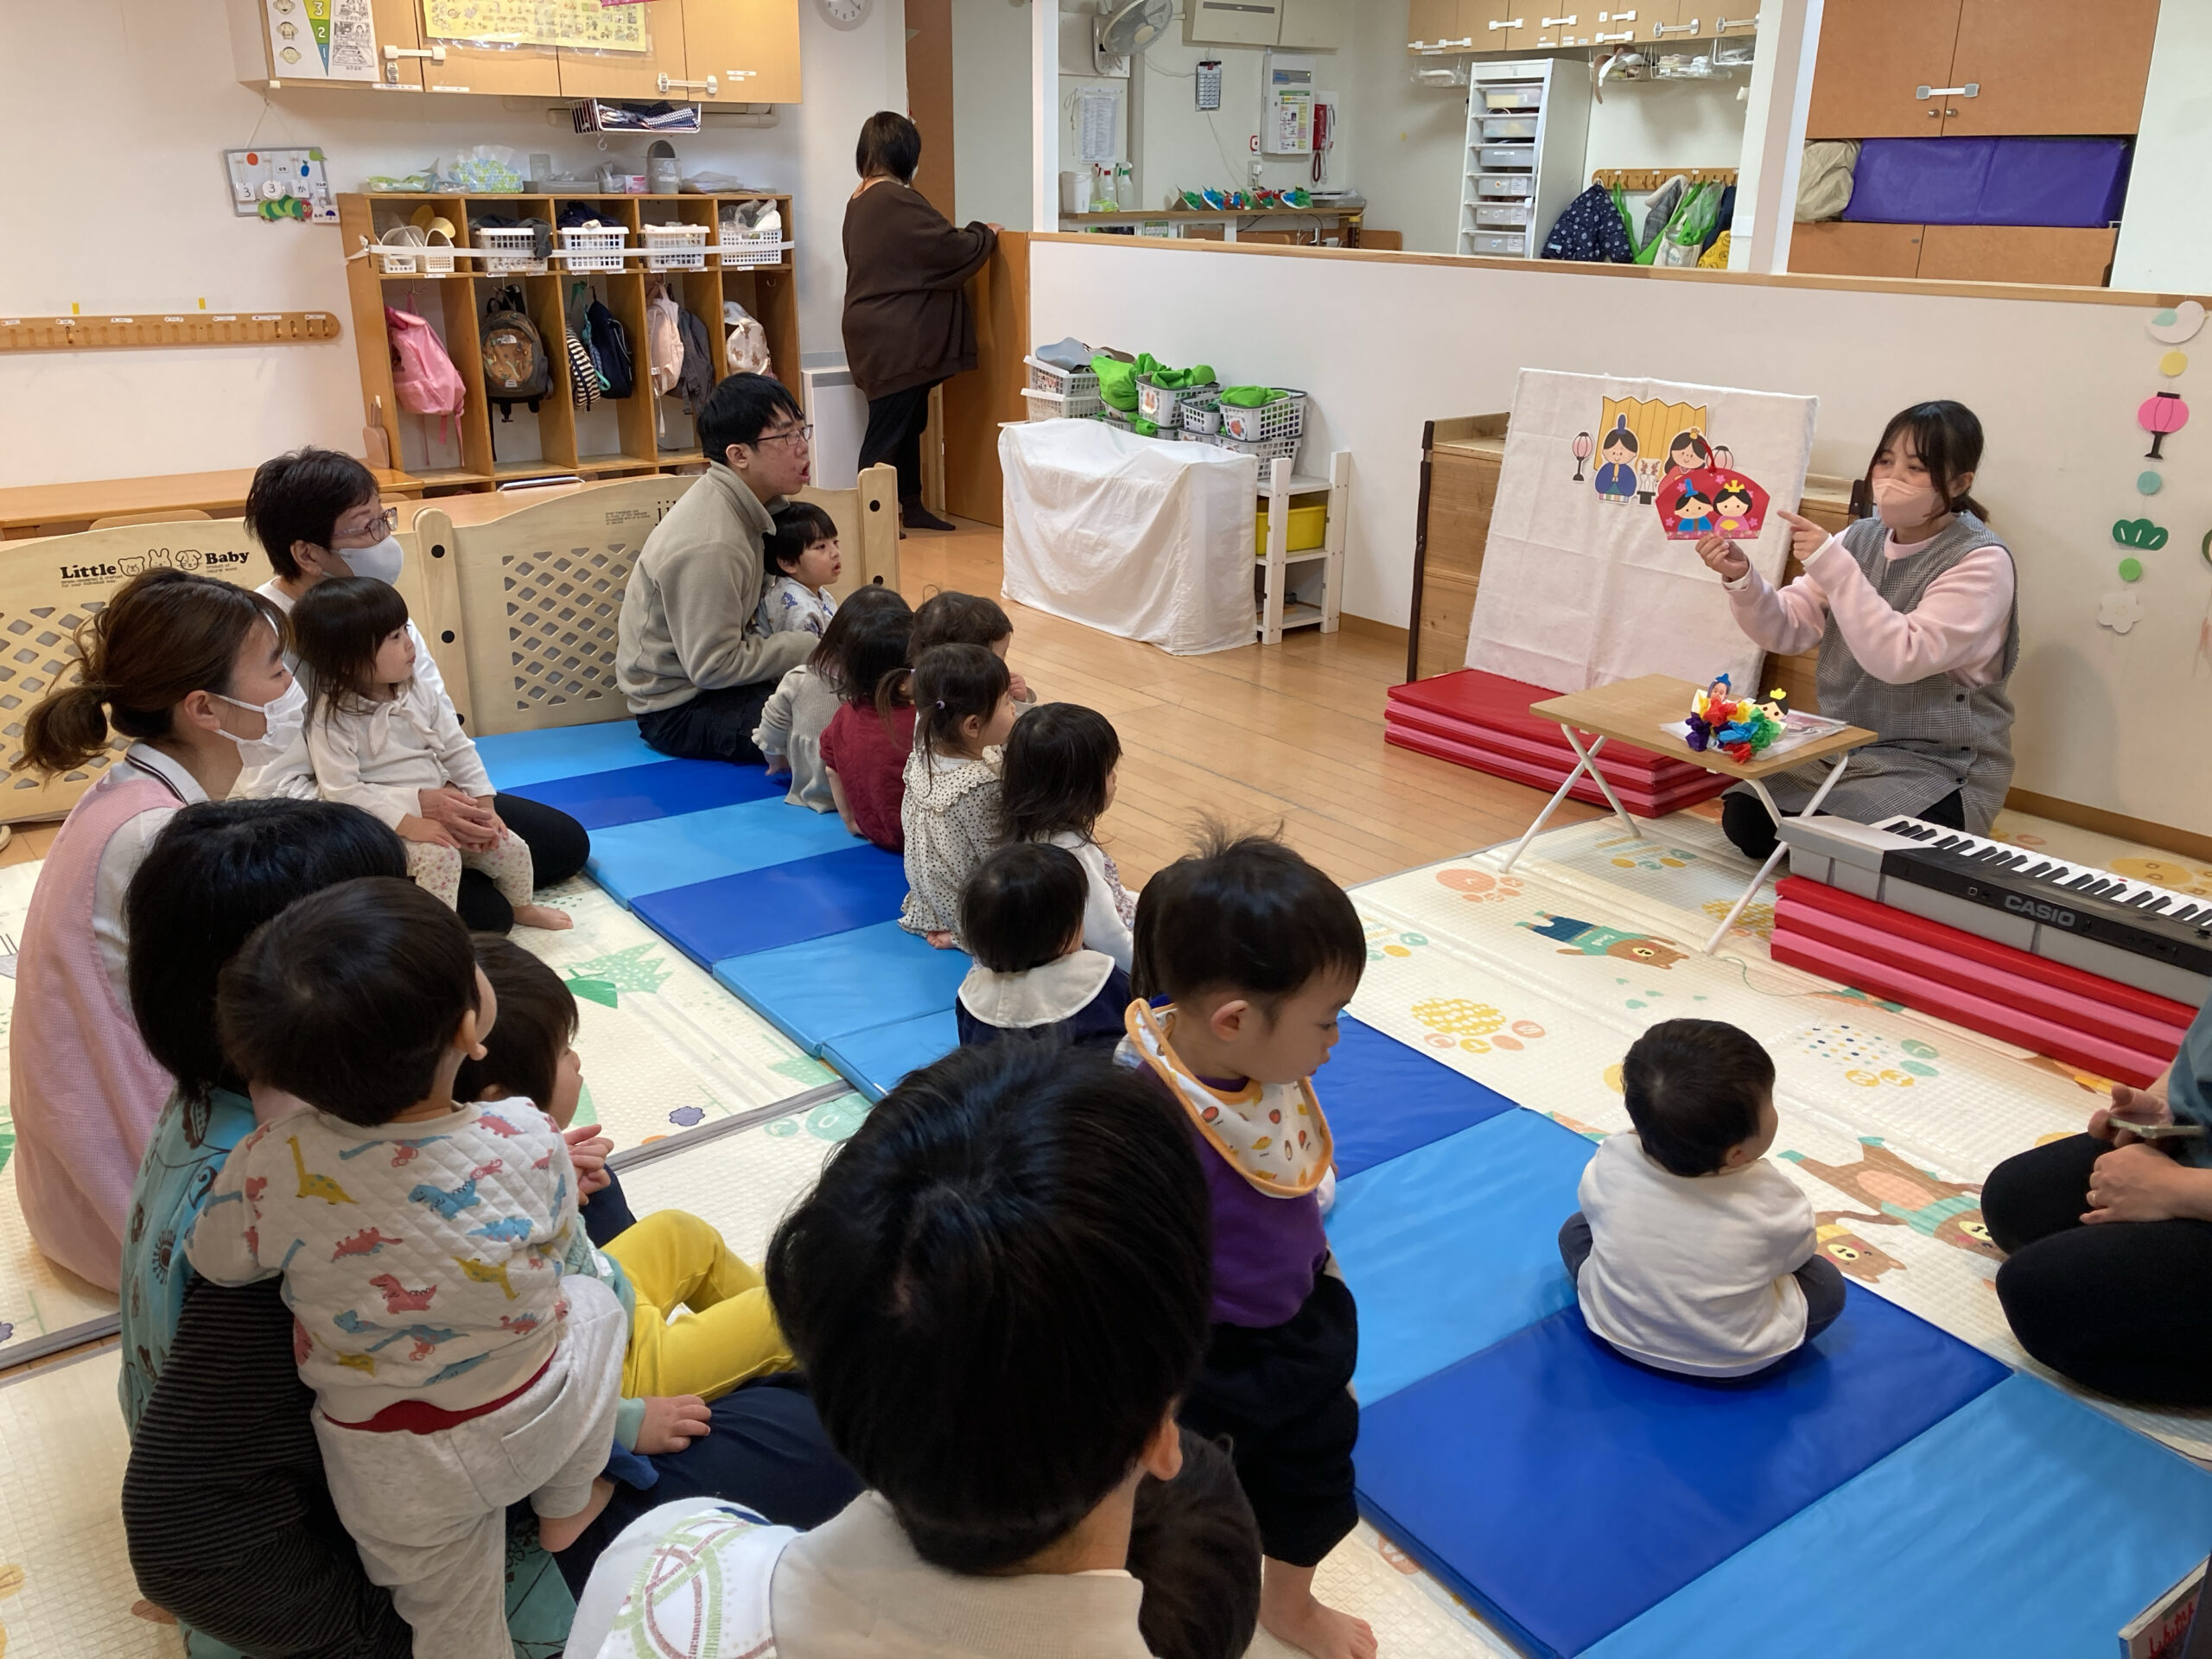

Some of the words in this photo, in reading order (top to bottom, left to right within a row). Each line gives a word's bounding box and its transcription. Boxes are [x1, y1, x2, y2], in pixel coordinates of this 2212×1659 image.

[314, 2, 323, 16] 3
[318, 27, 326, 38] 2
[322, 48, 326, 58] 1
[60, 563, 117, 579] Little
[205, 551, 250, 564] Baby
[2005, 894, 2076, 927] CASIO
